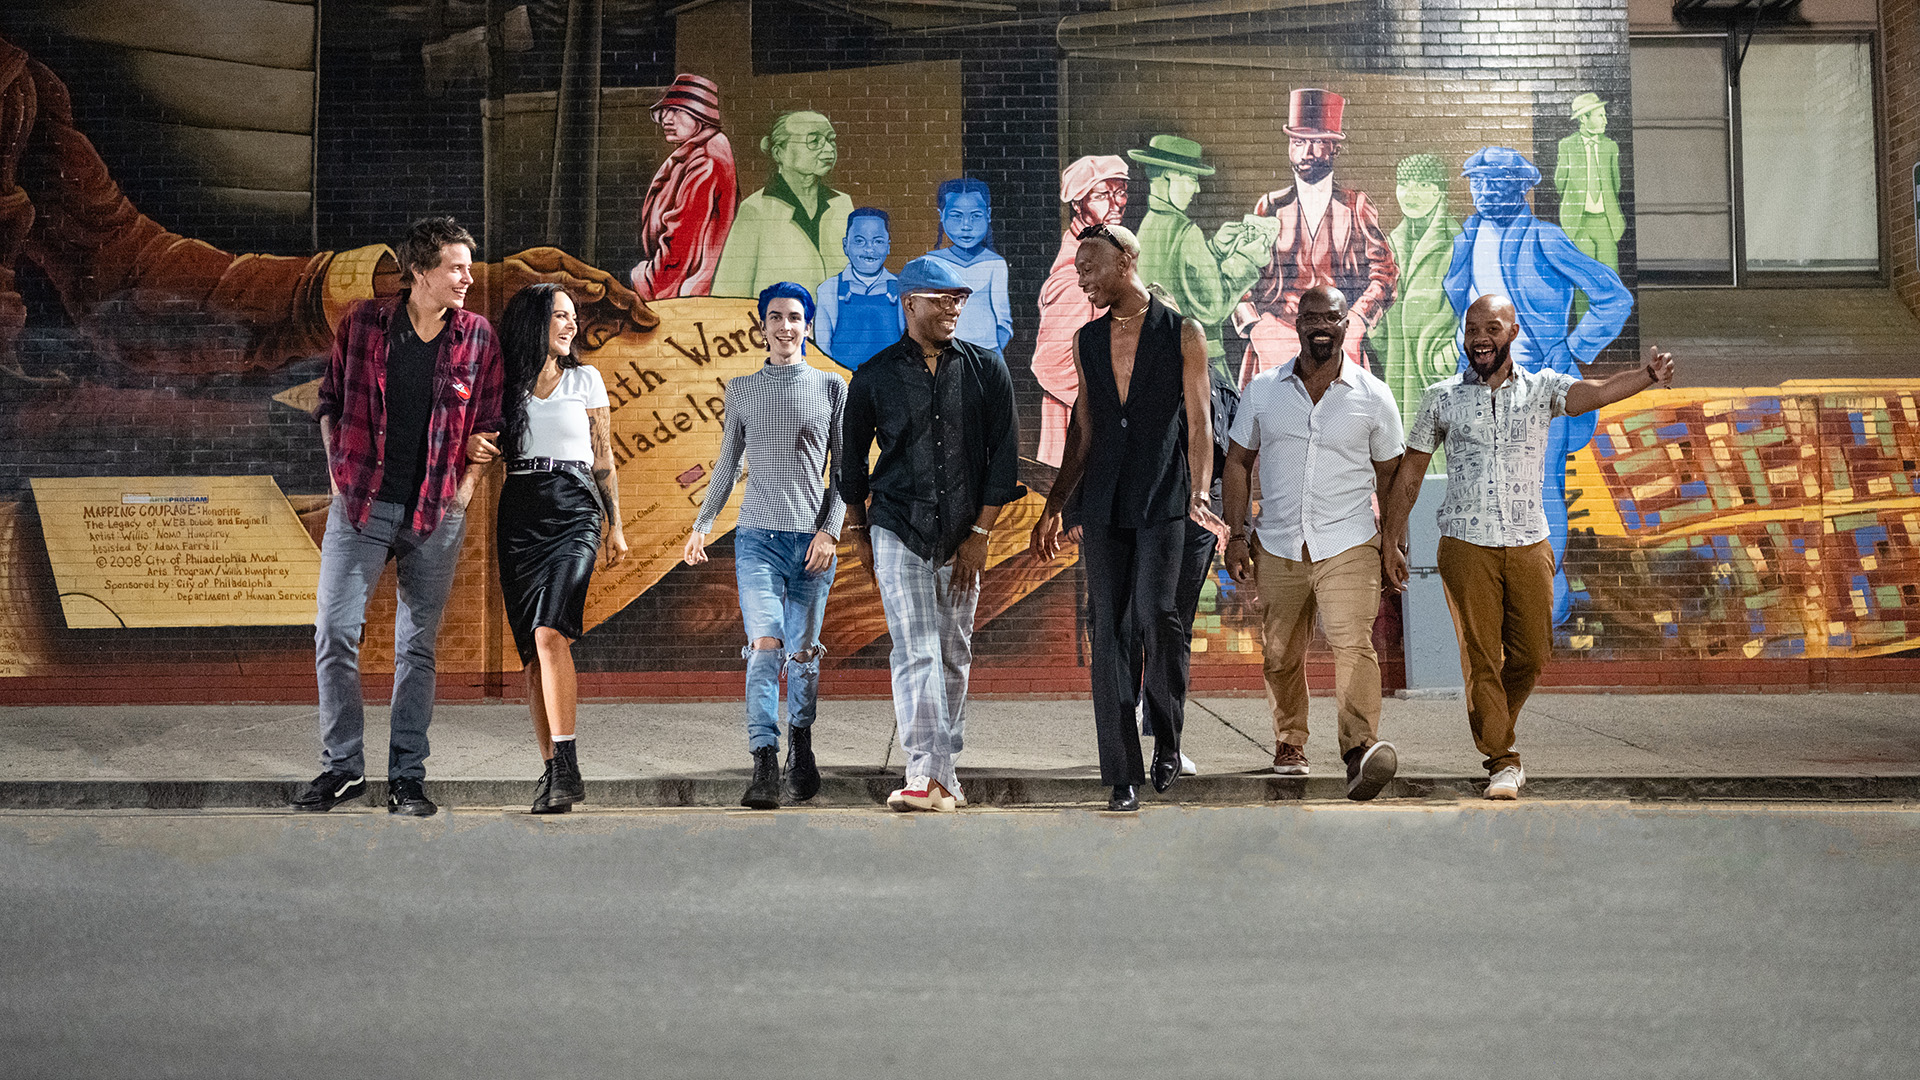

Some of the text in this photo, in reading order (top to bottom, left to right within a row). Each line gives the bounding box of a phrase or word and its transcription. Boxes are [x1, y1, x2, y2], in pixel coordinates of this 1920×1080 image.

[664, 311, 770, 367] Ward
[83, 506, 136, 519] MAPPING
[139, 504, 201, 518] COURAGE:
[84, 521, 104, 530] The
[107, 520, 141, 531] Legacy
[146, 519, 157, 529] of
[162, 519, 186, 528] WEB
[217, 517, 234, 526] and
[121, 530, 149, 541] Willis
[187, 527, 230, 544] Humphrey
[92, 542, 131, 555] Assisted
[154, 542, 180, 552] Adam
[182, 540, 219, 551] Farrell
[110, 554, 142, 568] 2008
[145, 555, 167, 566] City
[169, 552, 182, 566] of
[185, 552, 247, 567] Philadelphia
[249, 551, 279, 563] Mural
[147, 567, 168, 577] Arts
[244, 565, 290, 580] Humphrey
[104, 580, 155, 595] Sponsored
[176, 579, 195, 593] City
[197, 578, 210, 589] of
[213, 578, 273, 593] Philadelphia
[176, 590, 317, 605] Department of Human Services
